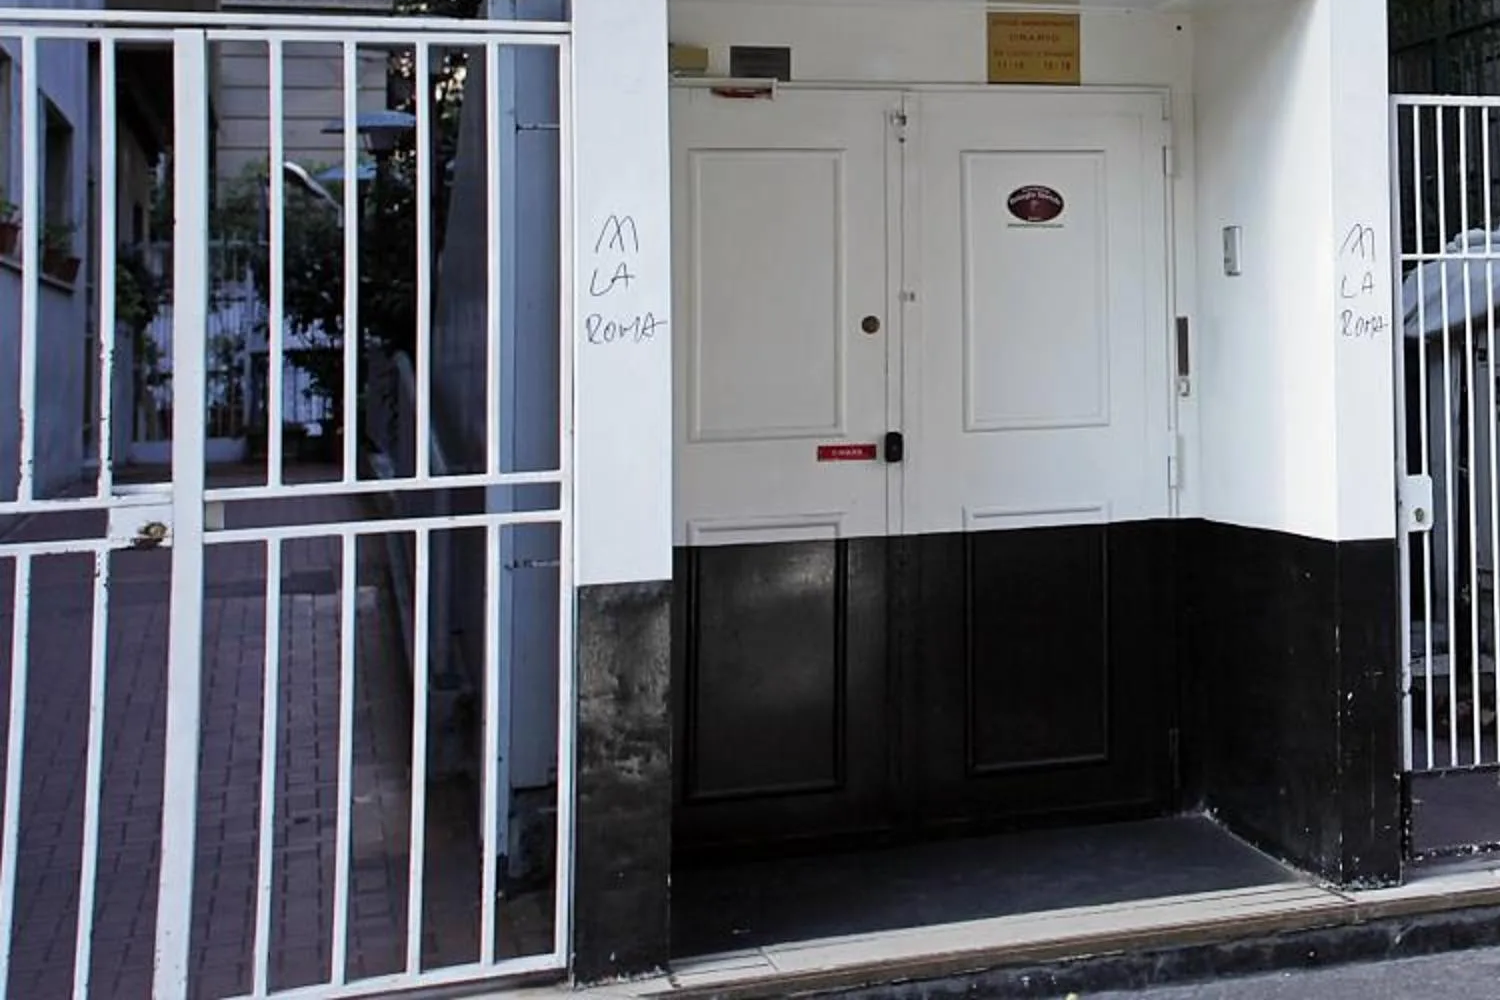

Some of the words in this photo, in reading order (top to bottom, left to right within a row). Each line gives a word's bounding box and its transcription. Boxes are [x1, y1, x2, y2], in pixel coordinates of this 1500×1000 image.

[589, 261, 636, 297] LA
[1341, 271, 1375, 299] LA
[585, 311, 668, 345] ROMA
